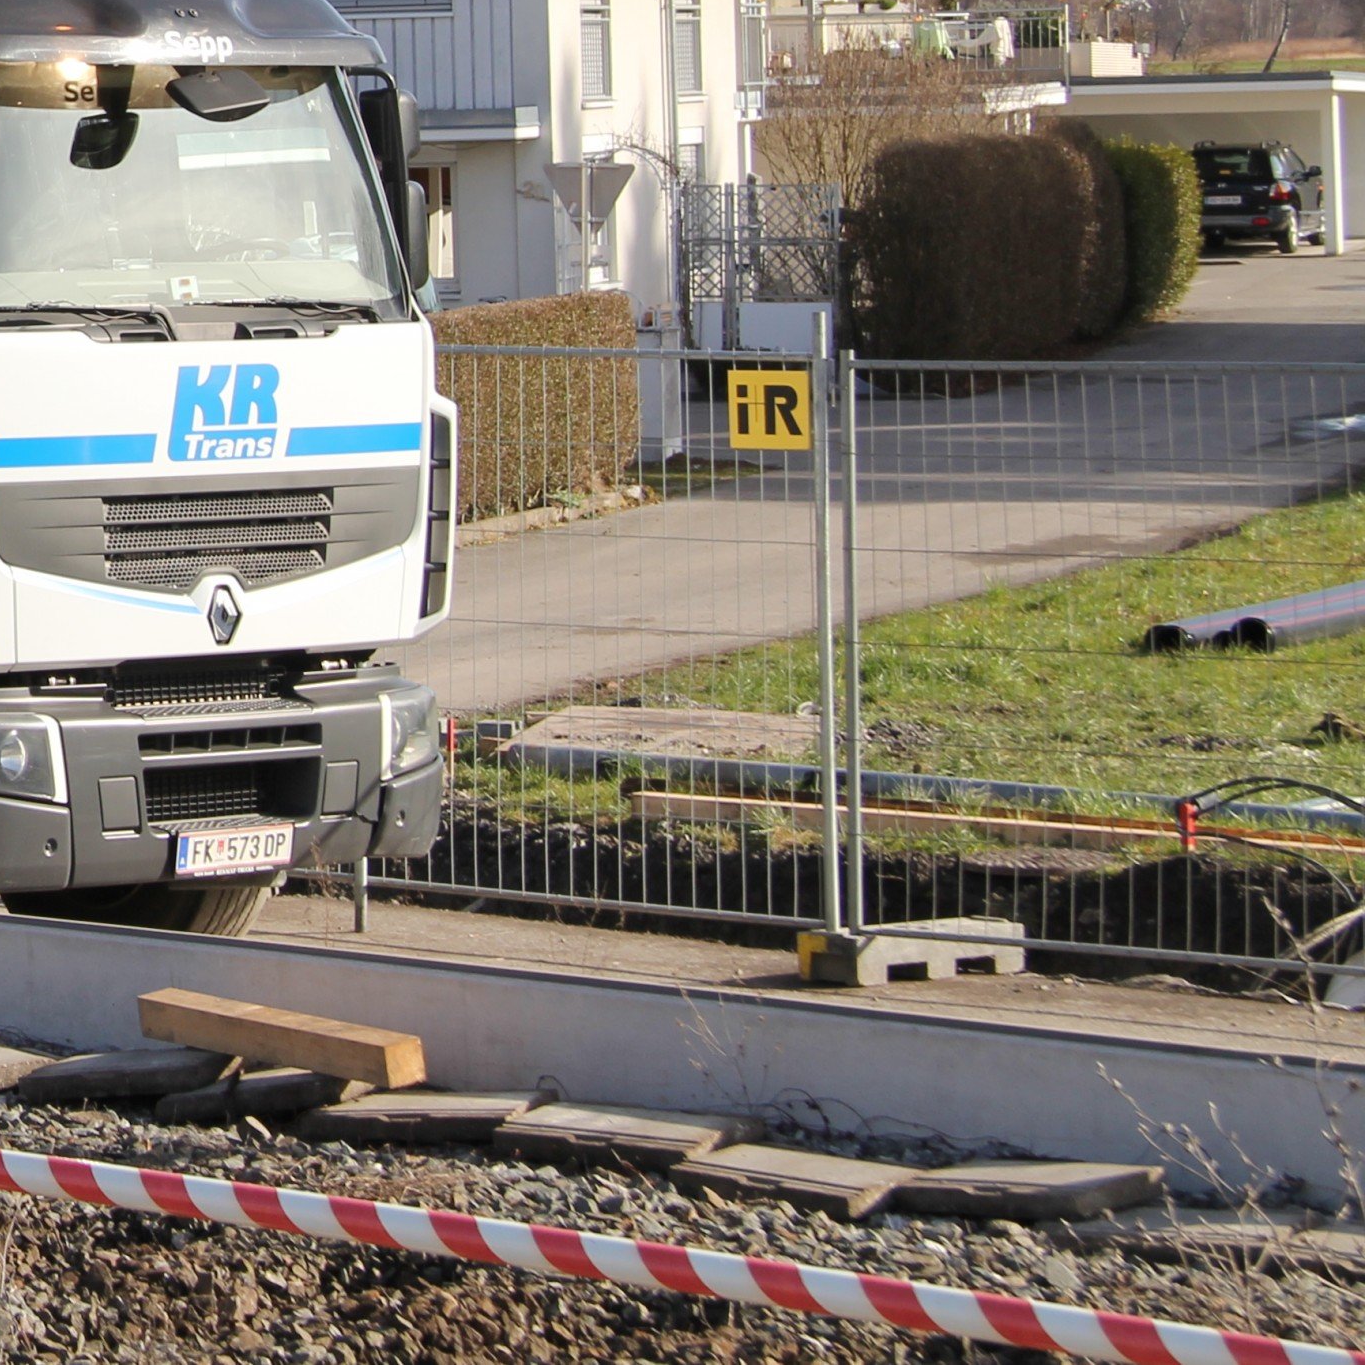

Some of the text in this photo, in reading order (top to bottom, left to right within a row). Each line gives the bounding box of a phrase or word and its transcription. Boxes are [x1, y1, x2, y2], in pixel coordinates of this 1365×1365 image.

[164, 30, 233, 63] Sepp
[171, 362, 280, 427] KR
[184, 434, 273, 460] Trans
[192, 838, 215, 865] FK
[227, 834, 260, 861] 573
[264, 832, 286, 857] DP
